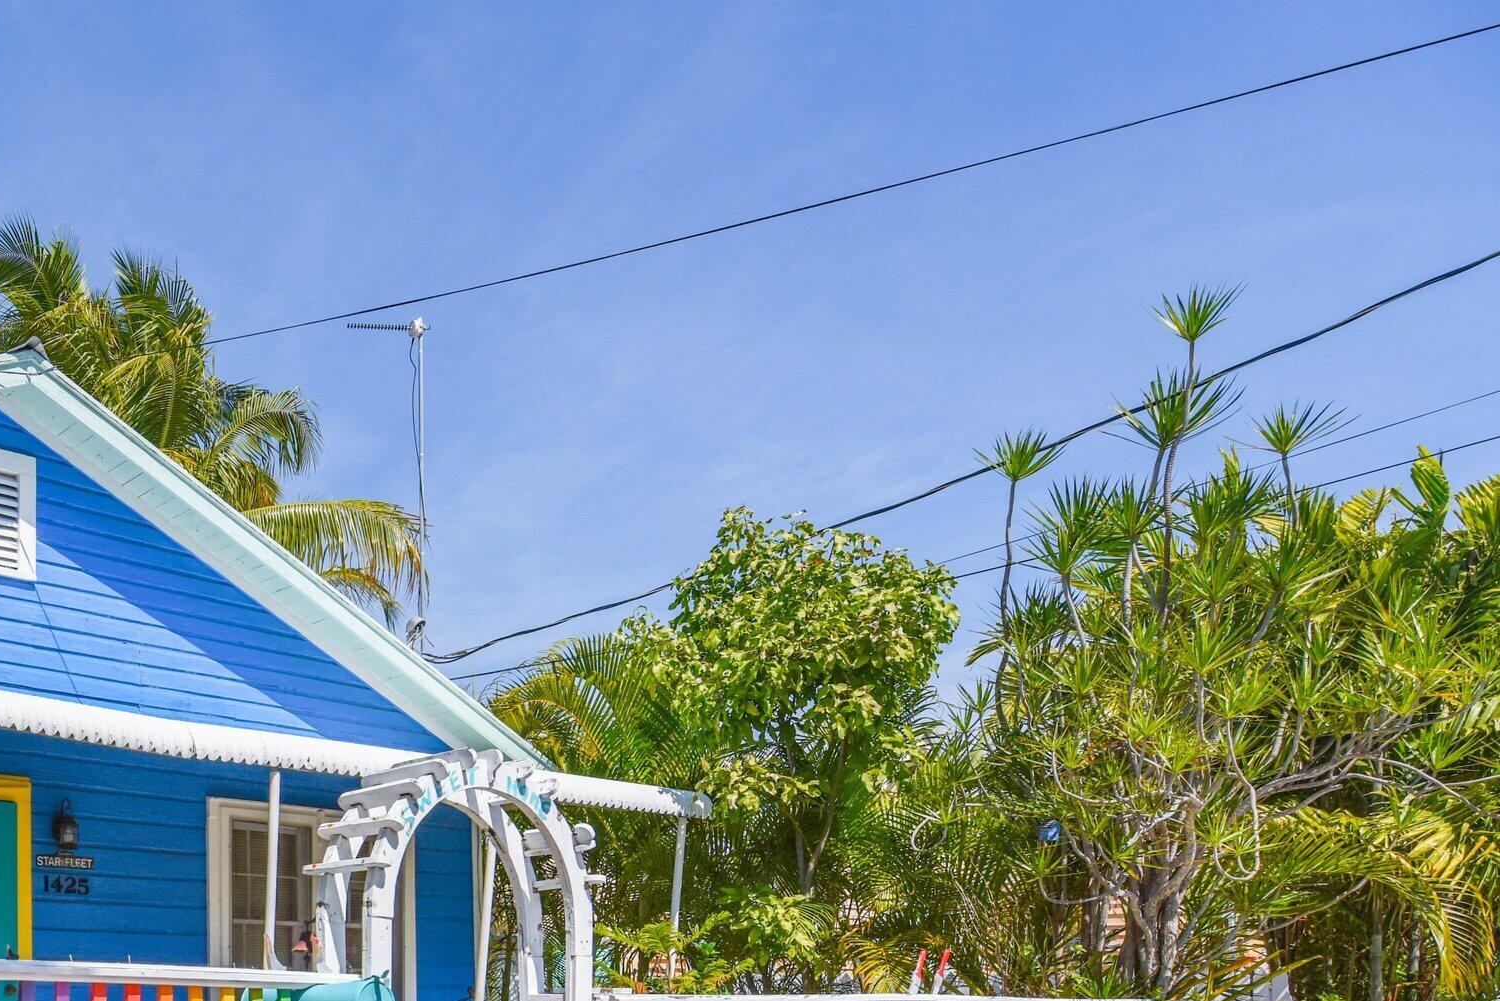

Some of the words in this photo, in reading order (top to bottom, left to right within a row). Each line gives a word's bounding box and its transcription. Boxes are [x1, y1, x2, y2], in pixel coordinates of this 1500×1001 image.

[36, 855, 61, 867] STAR
[65, 857, 93, 869] FLEET
[43, 873, 90, 896] 1425
